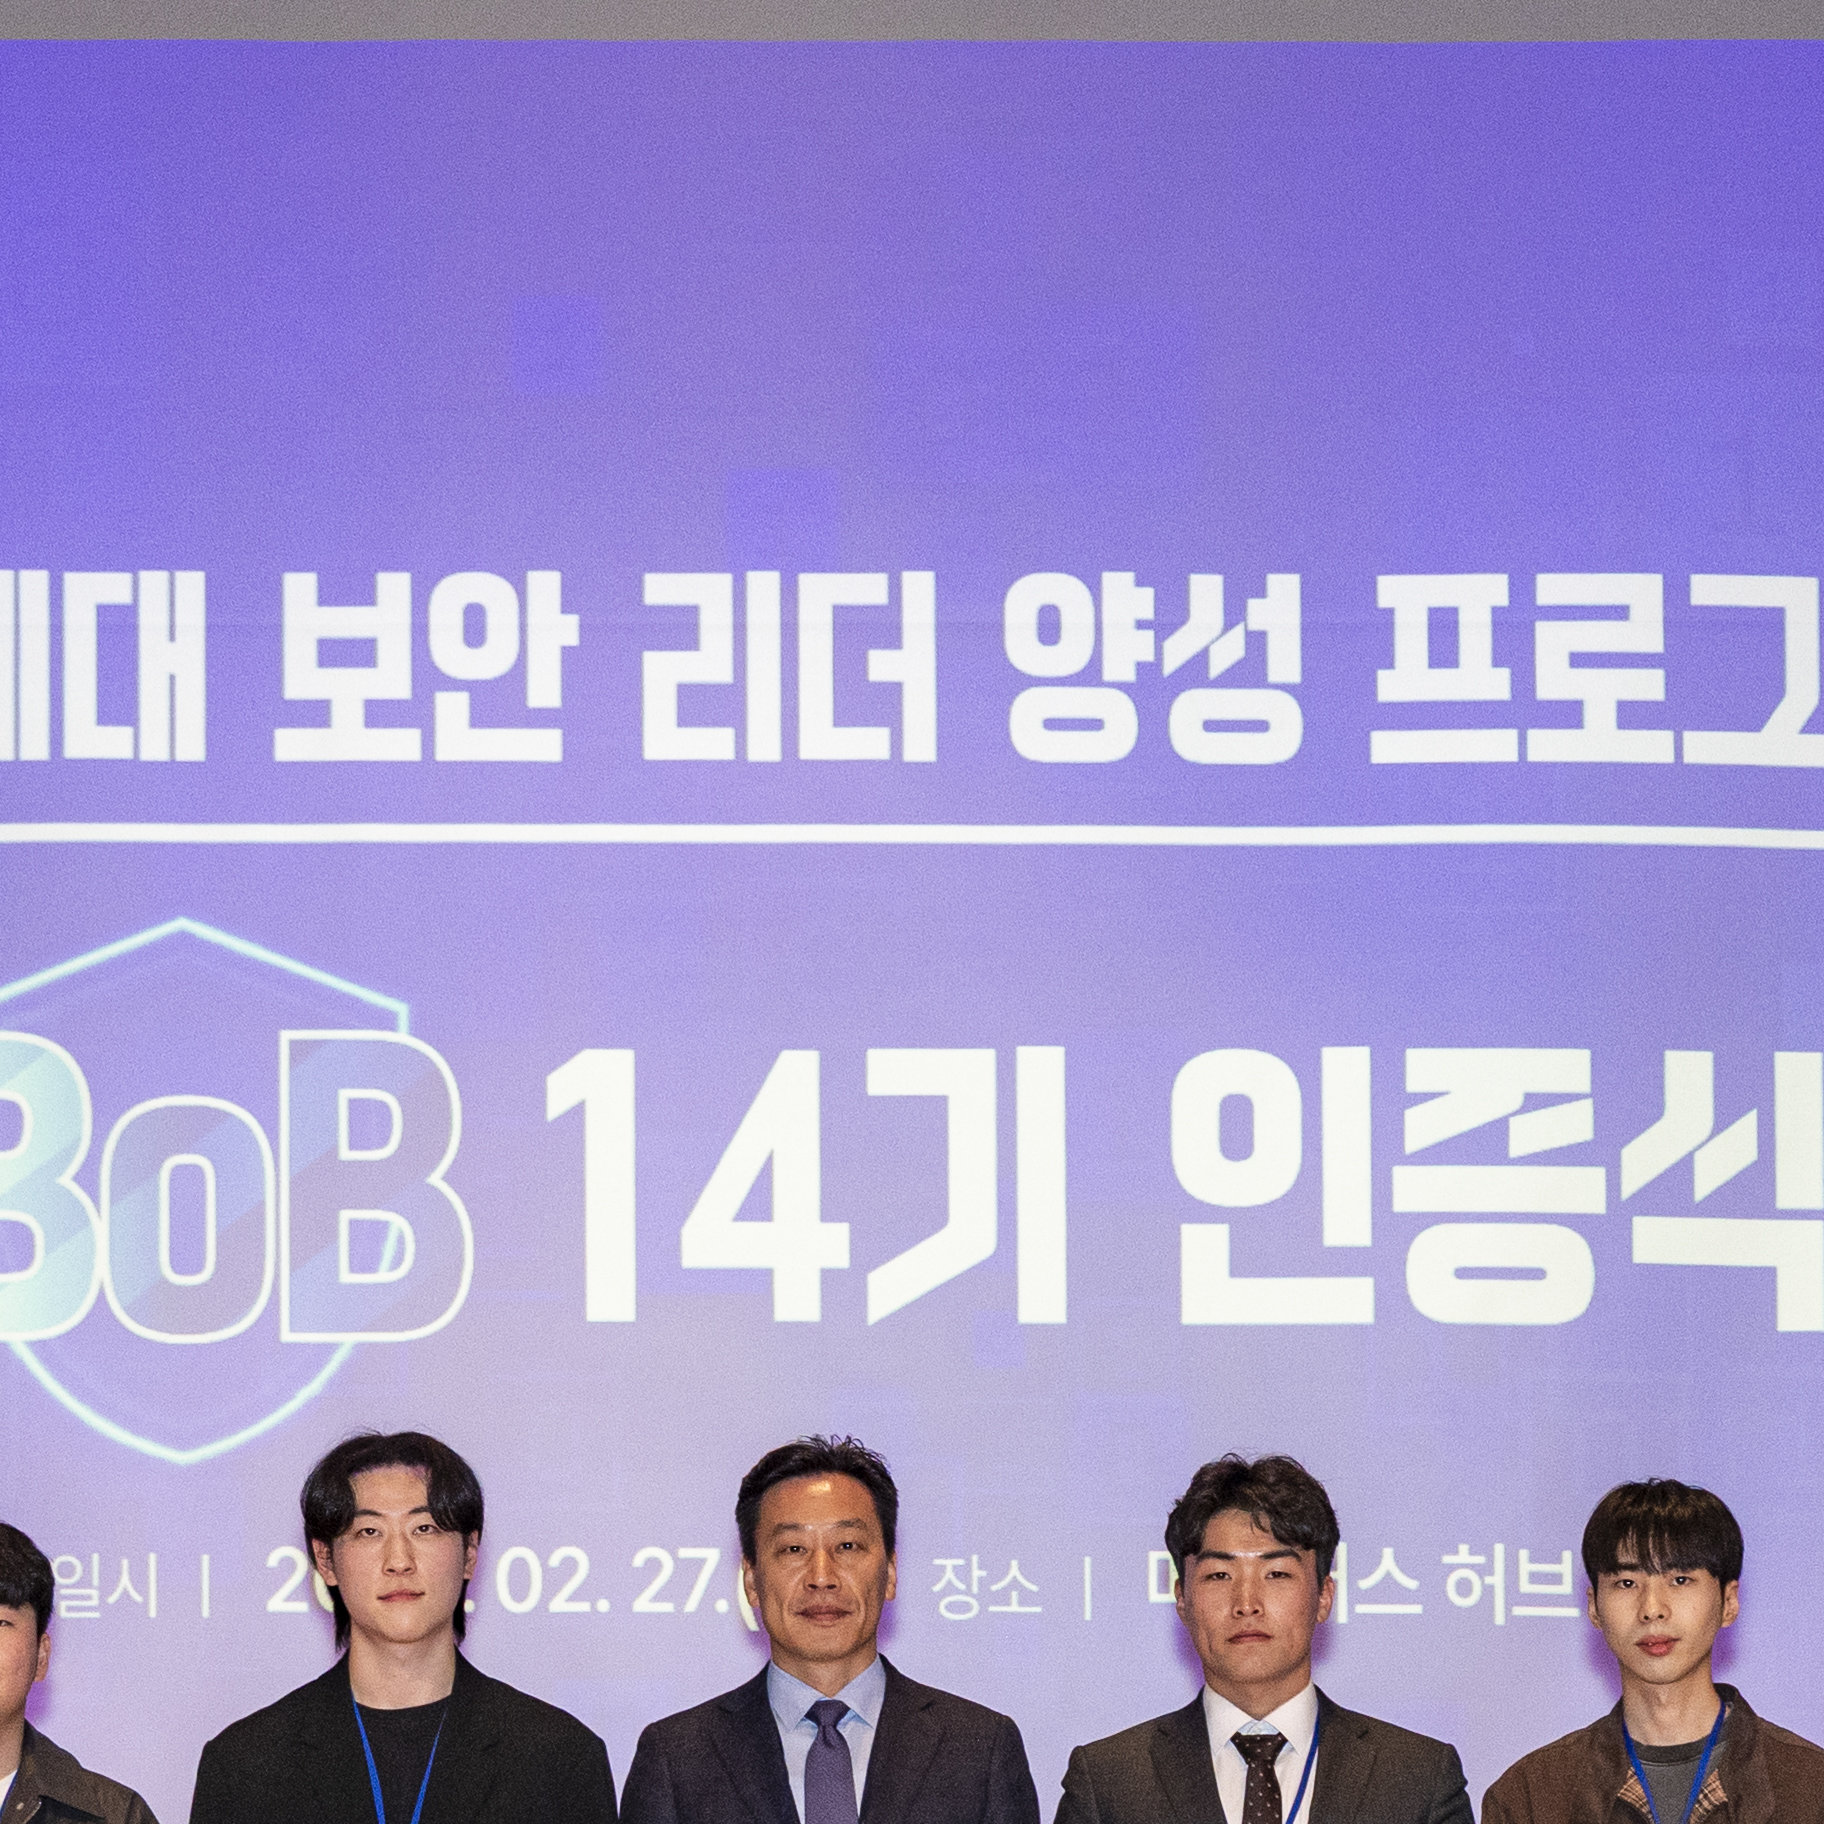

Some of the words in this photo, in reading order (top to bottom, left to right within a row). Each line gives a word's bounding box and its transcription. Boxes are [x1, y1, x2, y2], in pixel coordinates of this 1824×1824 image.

[272, 569, 581, 764] 보안
[641, 570, 938, 764] 리더
[1002, 571, 1305, 766] 양성
[545, 1044, 1068, 1328] 14기
[53, 1551, 157, 1619] 일시
[495, 1545, 611, 1614] 02.
[931, 1553, 1042, 1621] 장소
[1441, 1542, 1581, 1626] 허브
